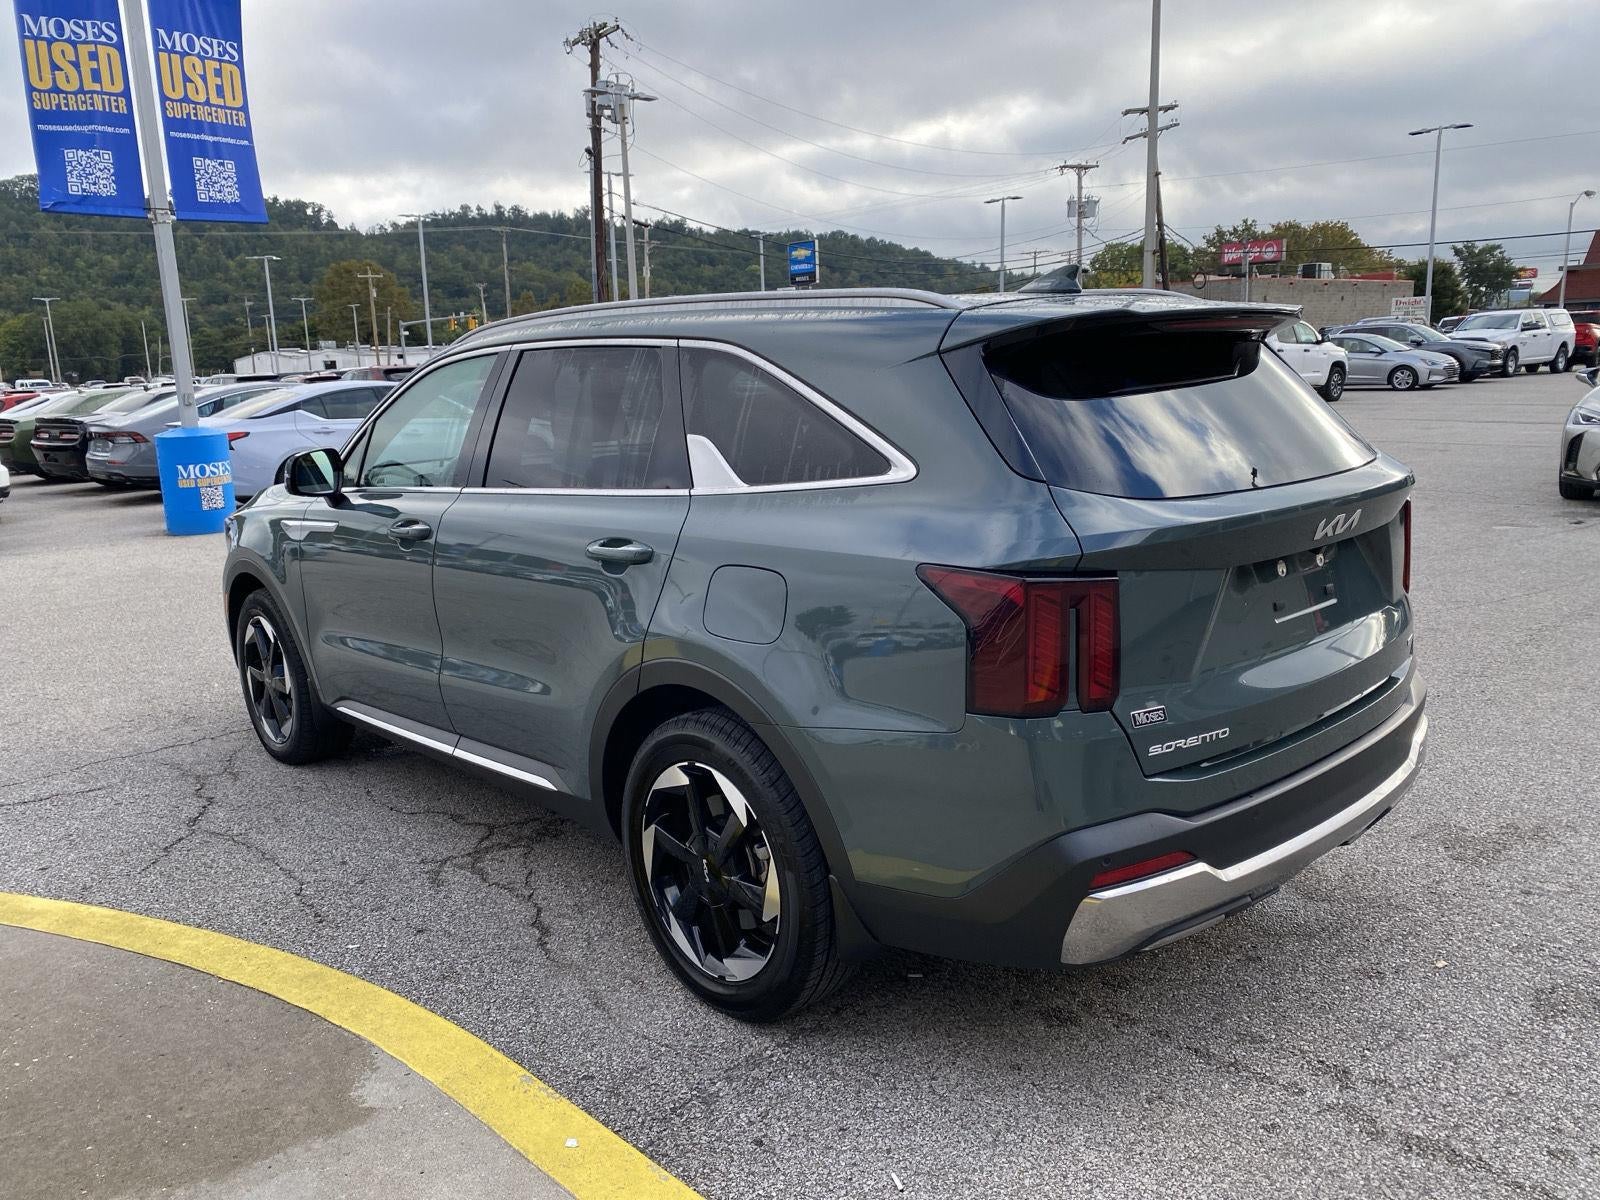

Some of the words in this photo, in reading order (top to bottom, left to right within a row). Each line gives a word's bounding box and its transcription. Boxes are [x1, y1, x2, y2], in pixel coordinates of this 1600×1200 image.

[20, 13, 118, 44] MOSES
[156, 28, 239, 62] MOSES
[23, 38, 125, 94] USED
[158, 51, 244, 108] USED
[32, 91, 128, 114] SUPERCENTER
[165, 101, 247, 128] SUPERCENTER
[37, 123, 130, 135] mosesusedsupercenter.com
[169, 130, 250, 146] mosesusedsupercenter.com
[176, 460, 231, 480] MOSES
[1313, 508, 1362, 542] KIA
[1148, 727, 1230, 757] SORENTO
